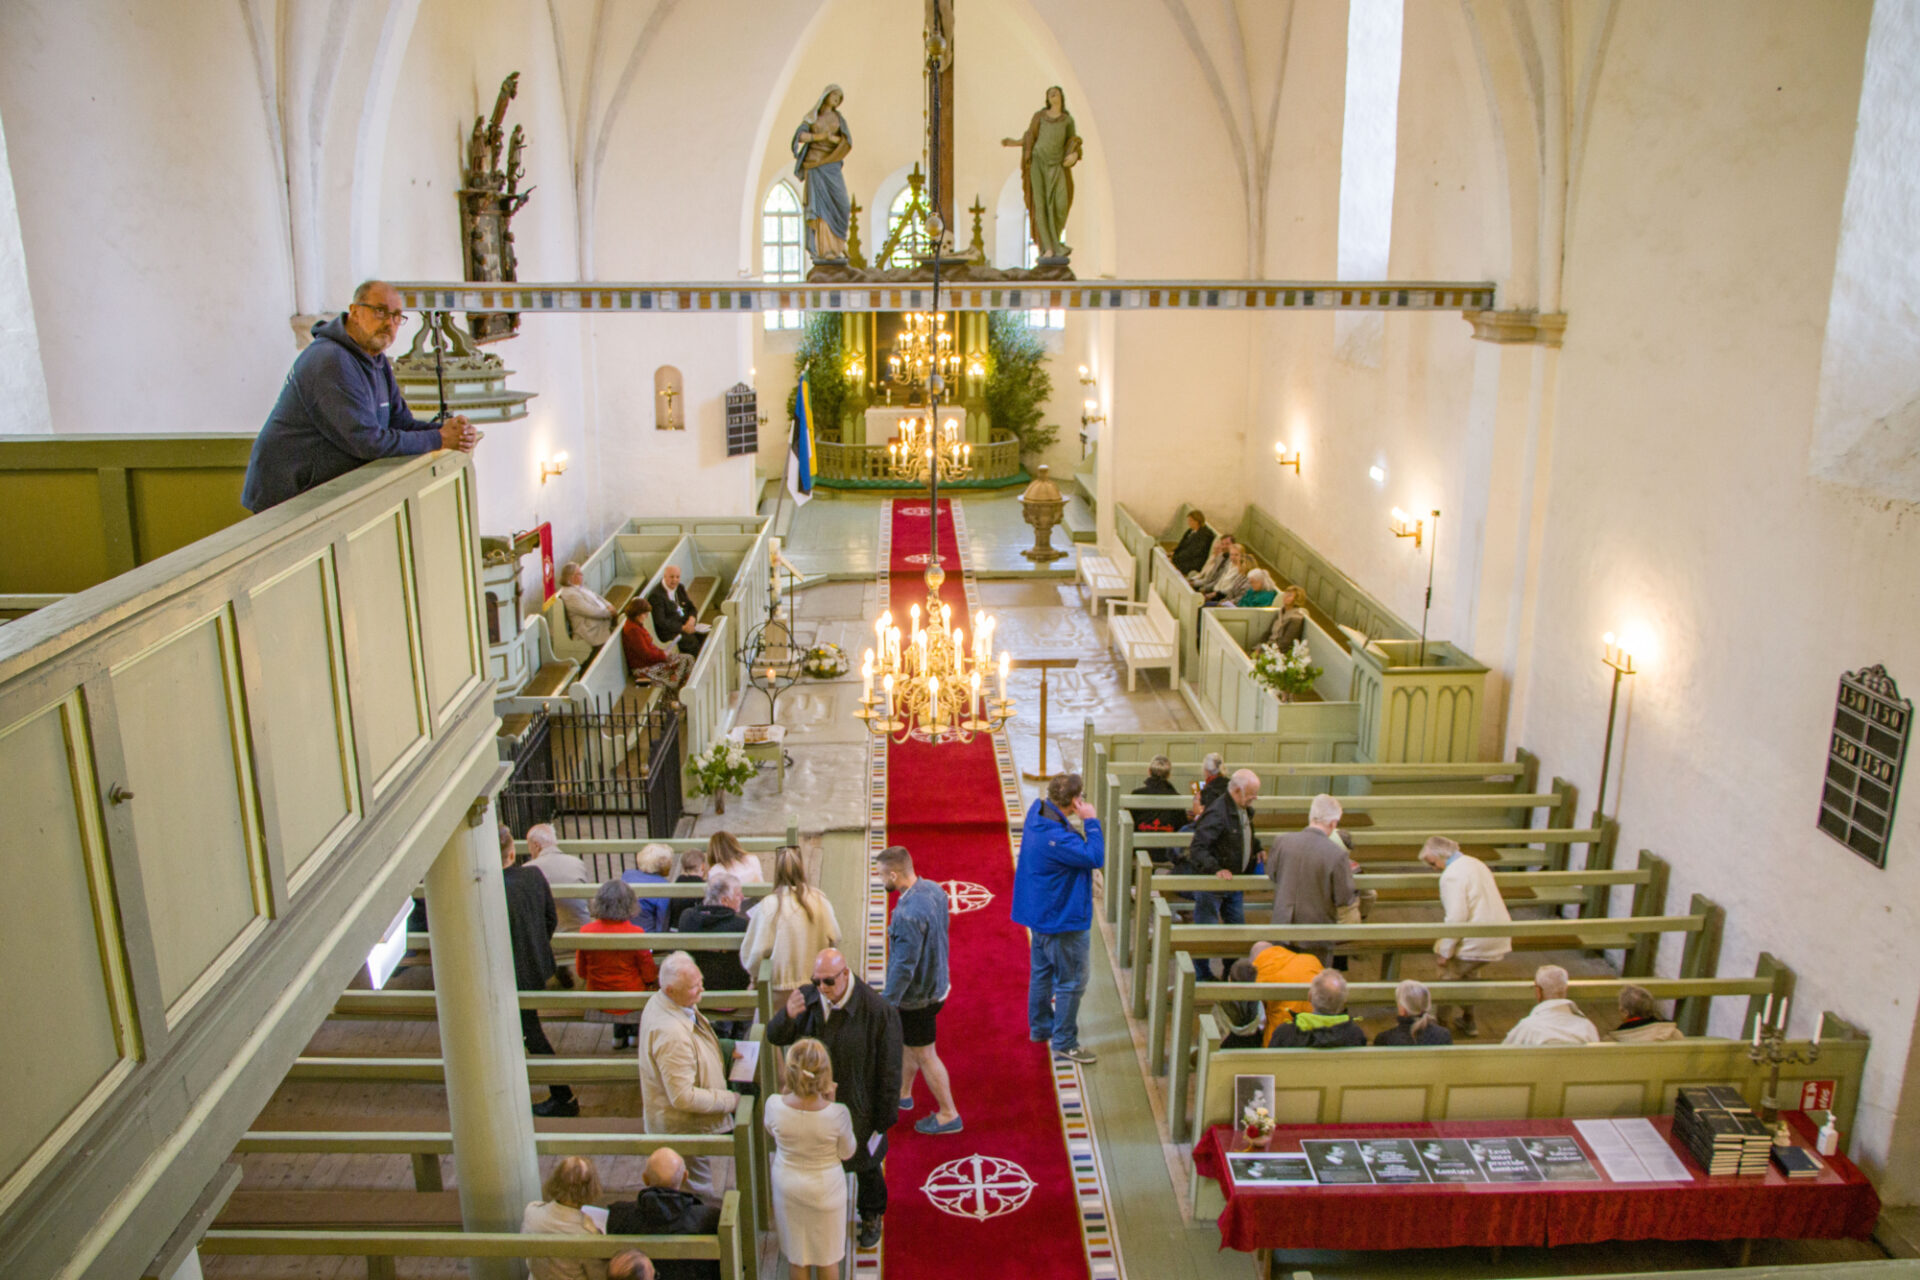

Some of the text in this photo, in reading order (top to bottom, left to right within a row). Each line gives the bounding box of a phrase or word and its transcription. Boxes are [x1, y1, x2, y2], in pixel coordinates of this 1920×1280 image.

[1841, 686, 1900, 729] 150 150
[1833, 736, 1891, 782] 150 150
